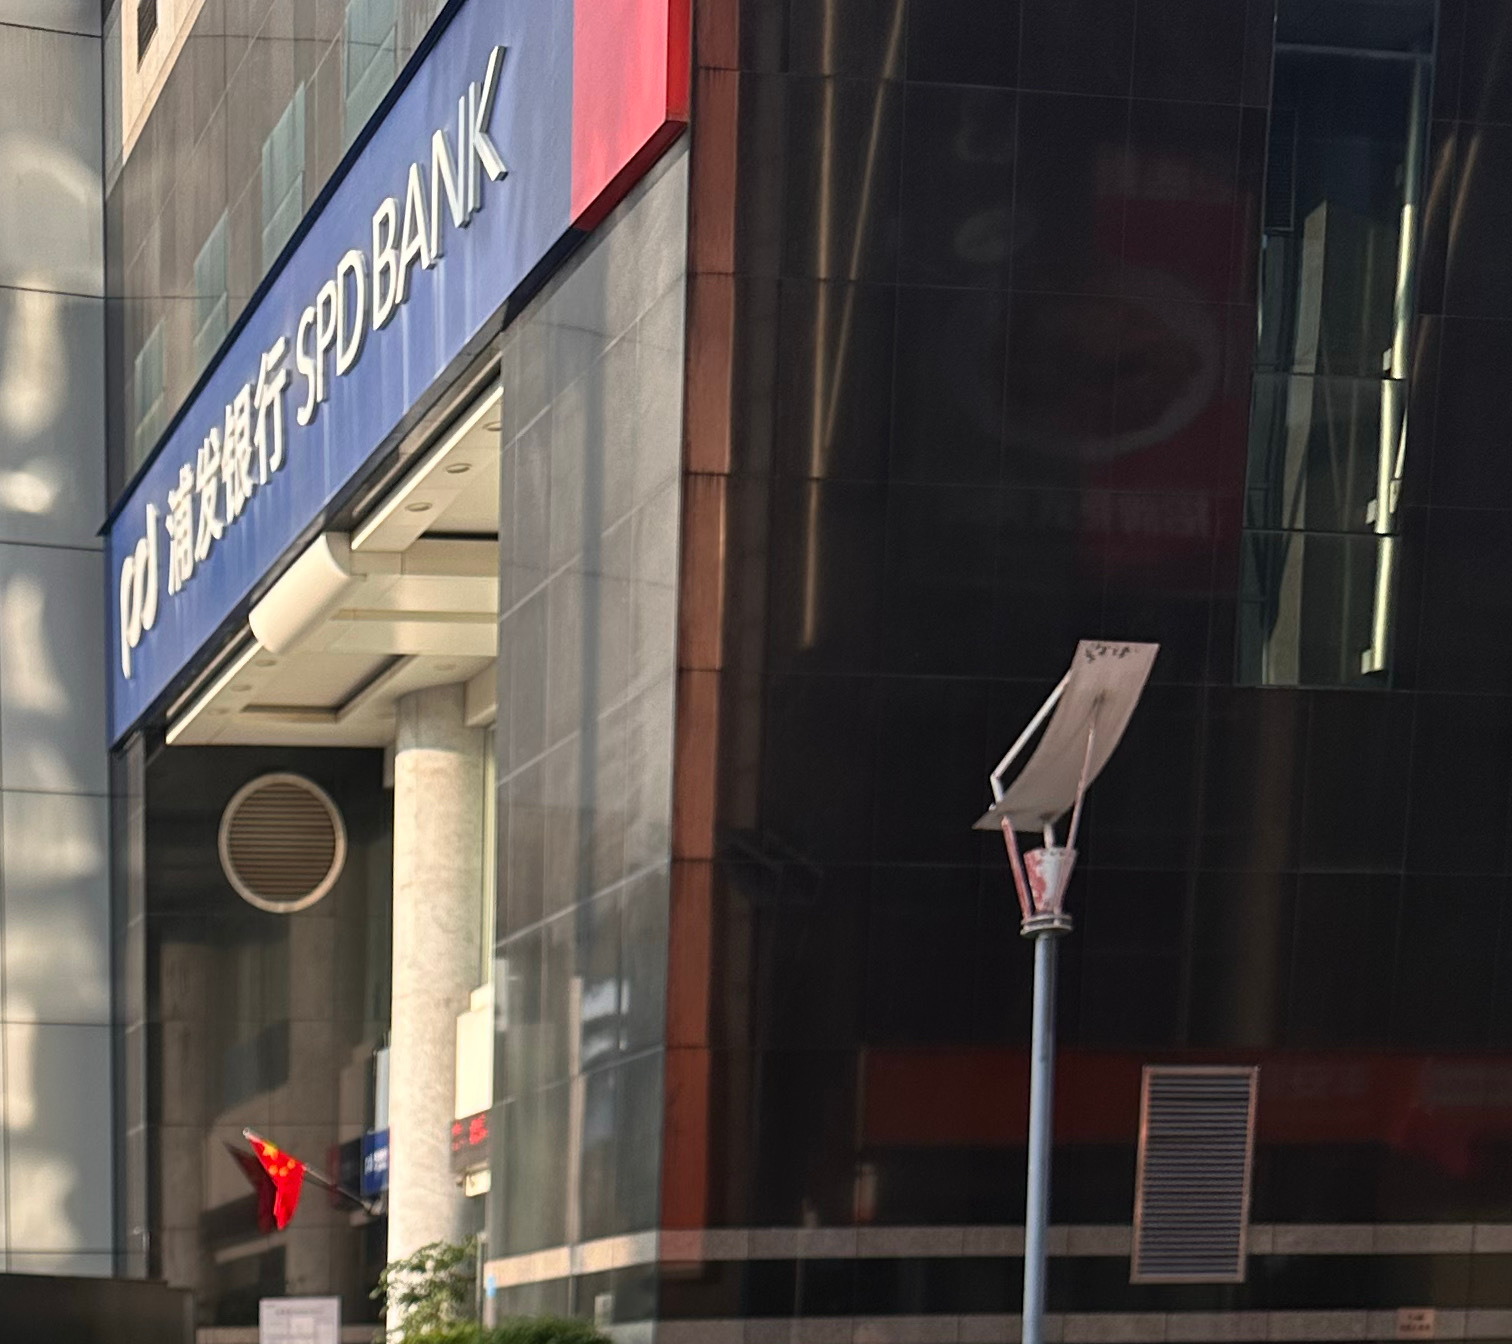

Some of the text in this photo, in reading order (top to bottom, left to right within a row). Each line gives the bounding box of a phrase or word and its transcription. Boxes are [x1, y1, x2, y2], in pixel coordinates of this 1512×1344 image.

[166, 336, 289, 596] 浦发银行
[296, 250, 368, 426] SPD
[372, 45, 508, 331] BANK
